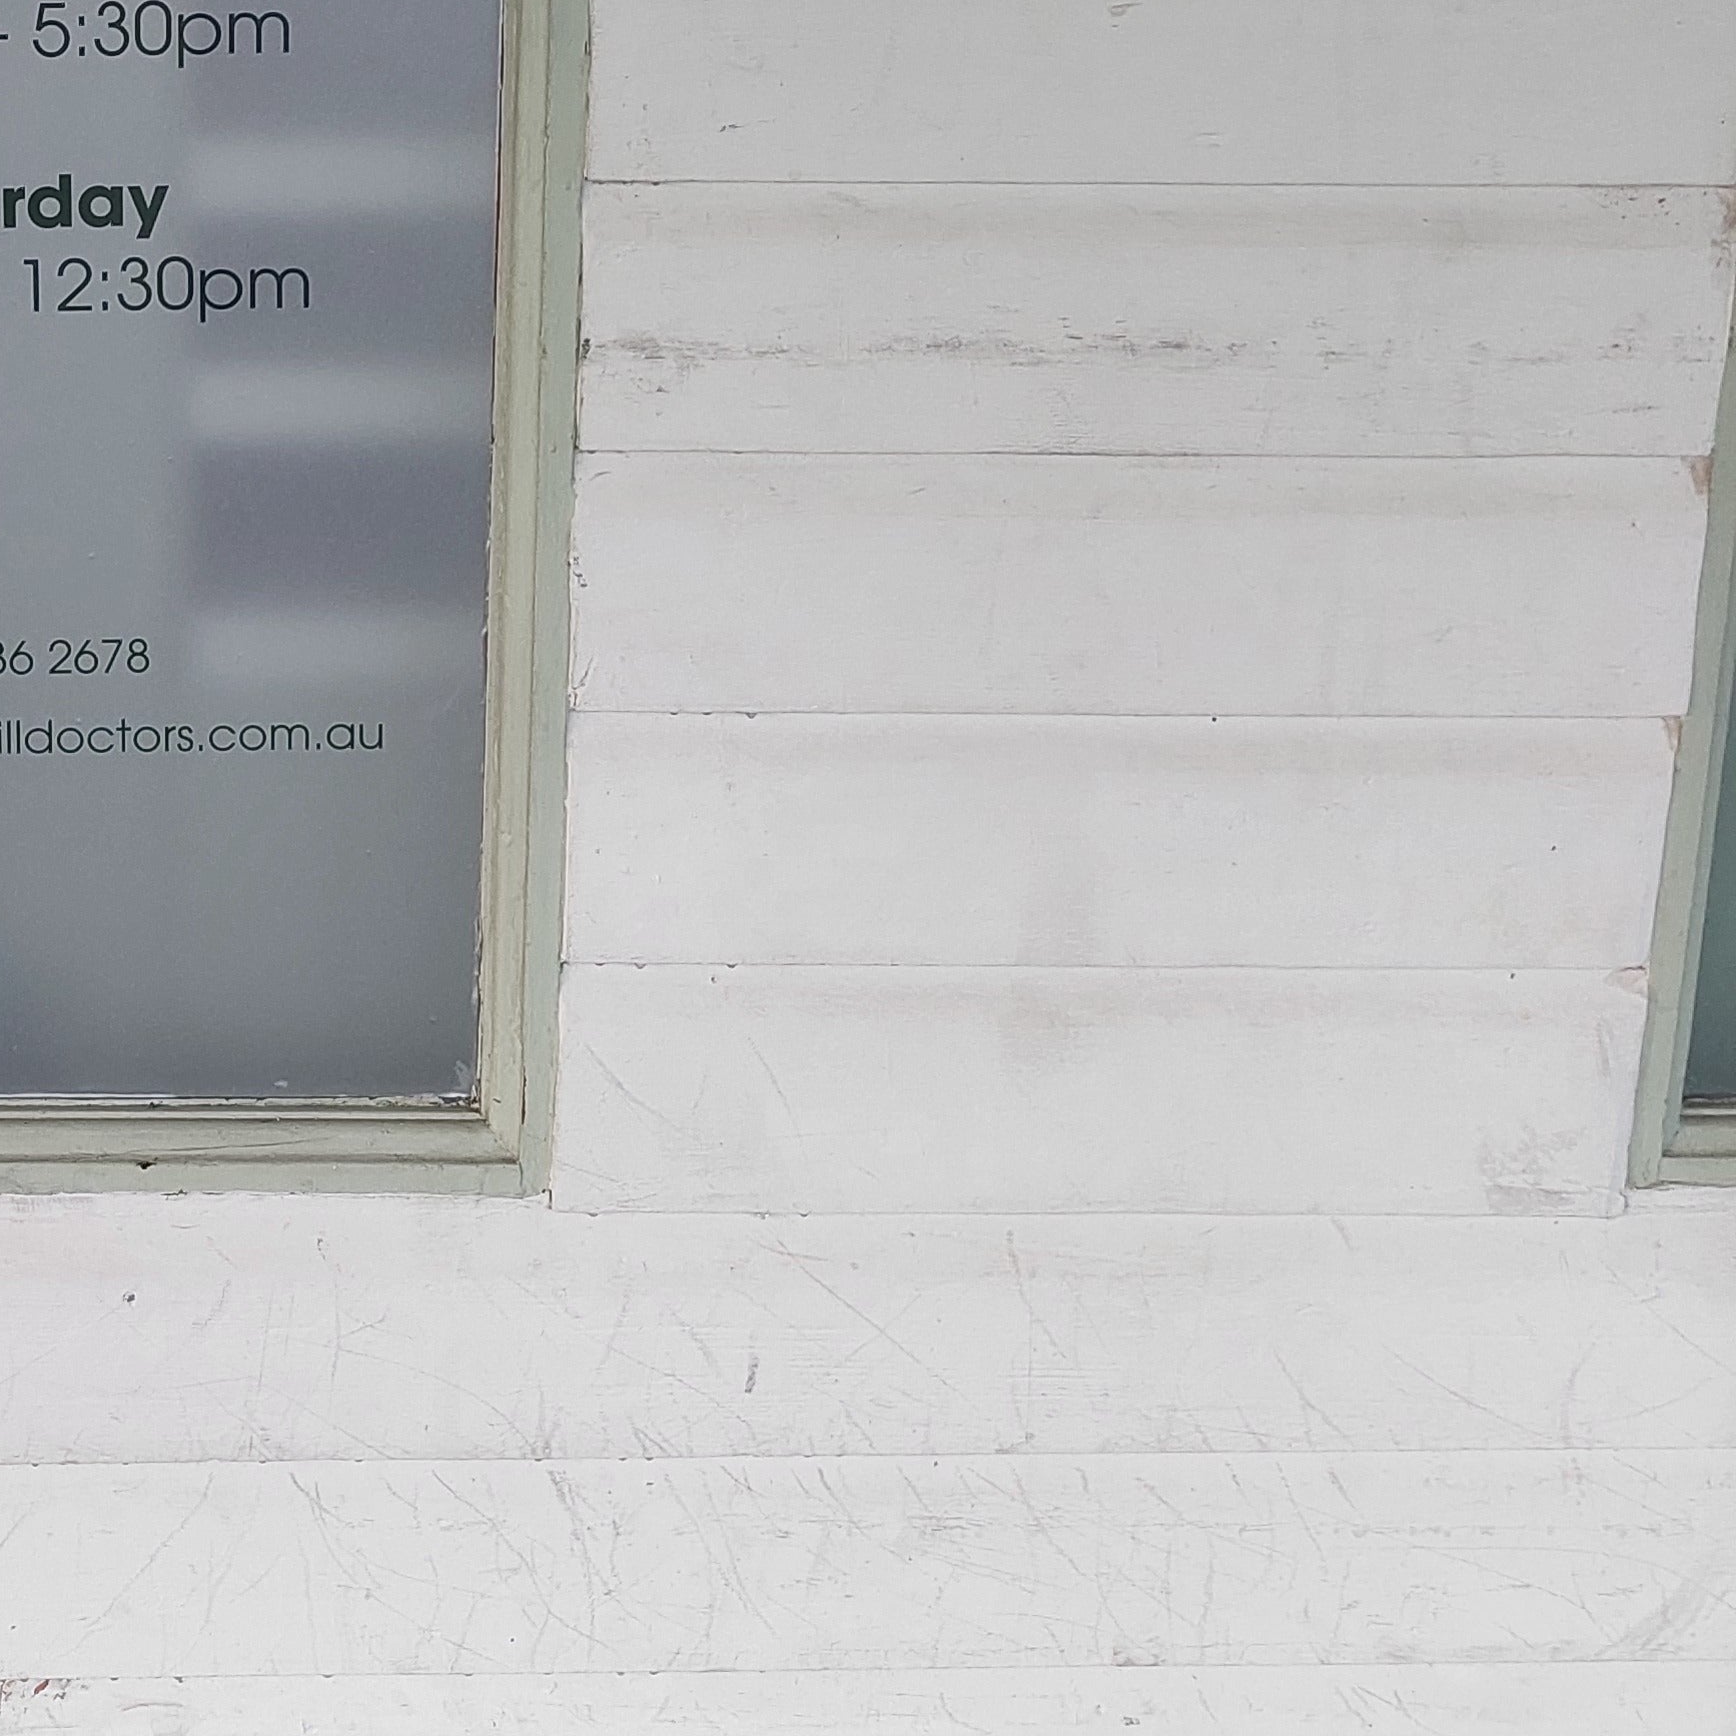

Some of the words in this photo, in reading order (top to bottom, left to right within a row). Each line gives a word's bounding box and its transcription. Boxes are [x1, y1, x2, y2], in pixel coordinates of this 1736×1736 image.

[33, 0, 290, 69] 5:30pm
[24, 256, 310, 322] 12:30pm
[49, 638, 150, 674] 2678
